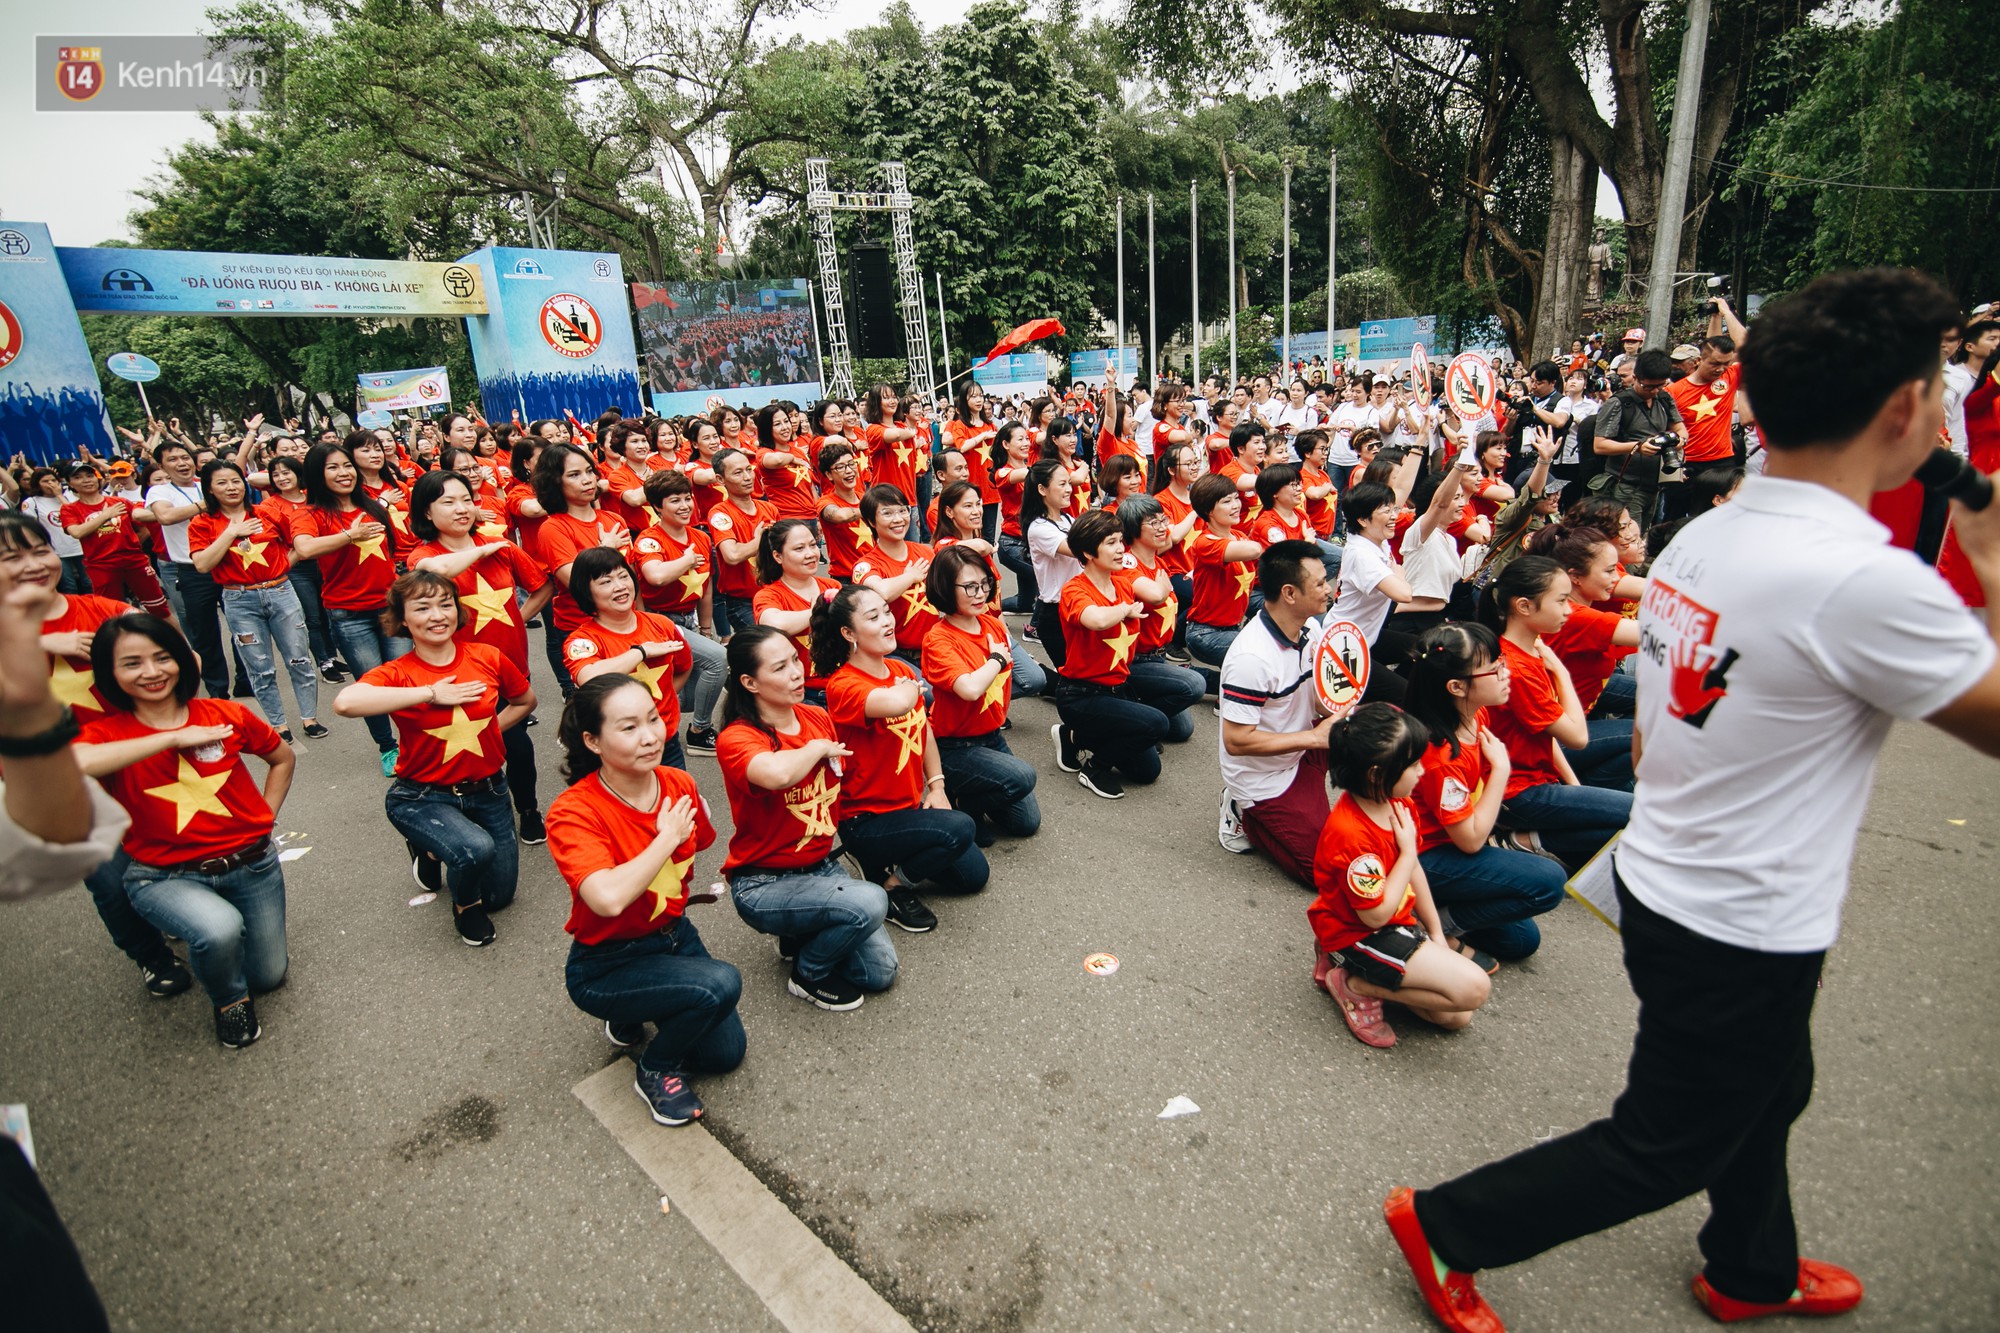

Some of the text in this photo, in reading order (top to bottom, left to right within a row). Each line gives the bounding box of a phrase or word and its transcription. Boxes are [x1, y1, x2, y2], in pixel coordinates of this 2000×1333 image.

[265, 266, 276, 274] ĐI
[315, 268, 332, 277] GỌI
[213, 275, 255, 290] UỐNG
[258, 277, 298, 293] RƯỢU
[300, 280, 323, 291] BIA
[334, 279, 380, 293] KHÔNG
[1641, 585, 1708, 644] KHÔNG
